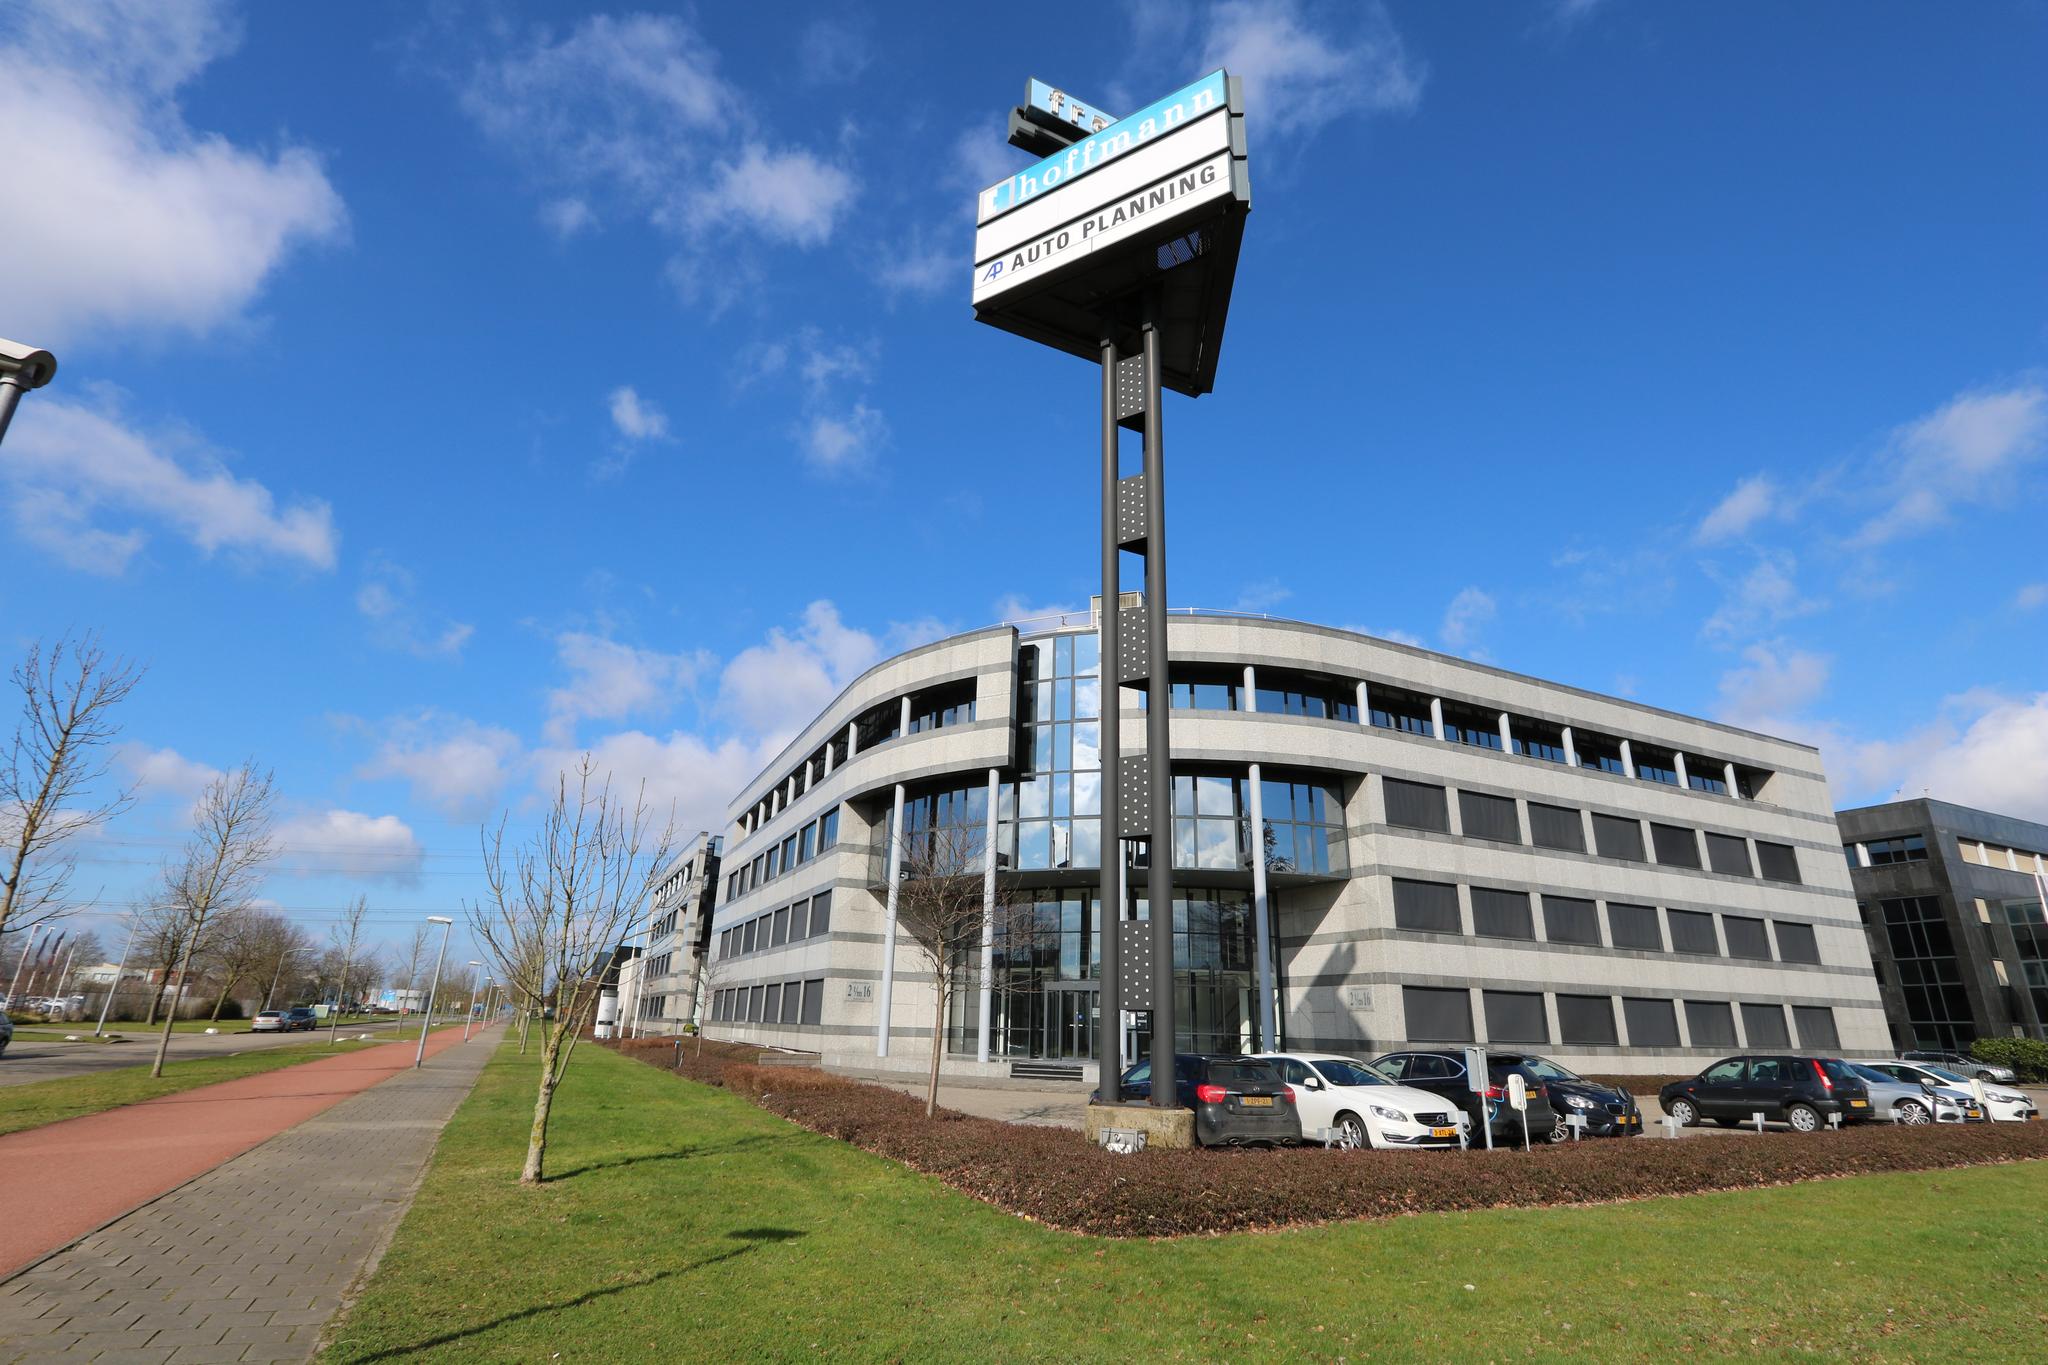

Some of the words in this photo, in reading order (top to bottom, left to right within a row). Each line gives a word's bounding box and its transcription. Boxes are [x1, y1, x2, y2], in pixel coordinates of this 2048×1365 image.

[1018, 87, 1216, 201] hoffmann
[1011, 231, 1070, 271] AUTO
[1082, 165, 1216, 239] PLANNING
[863, 985, 871, 998] 16
